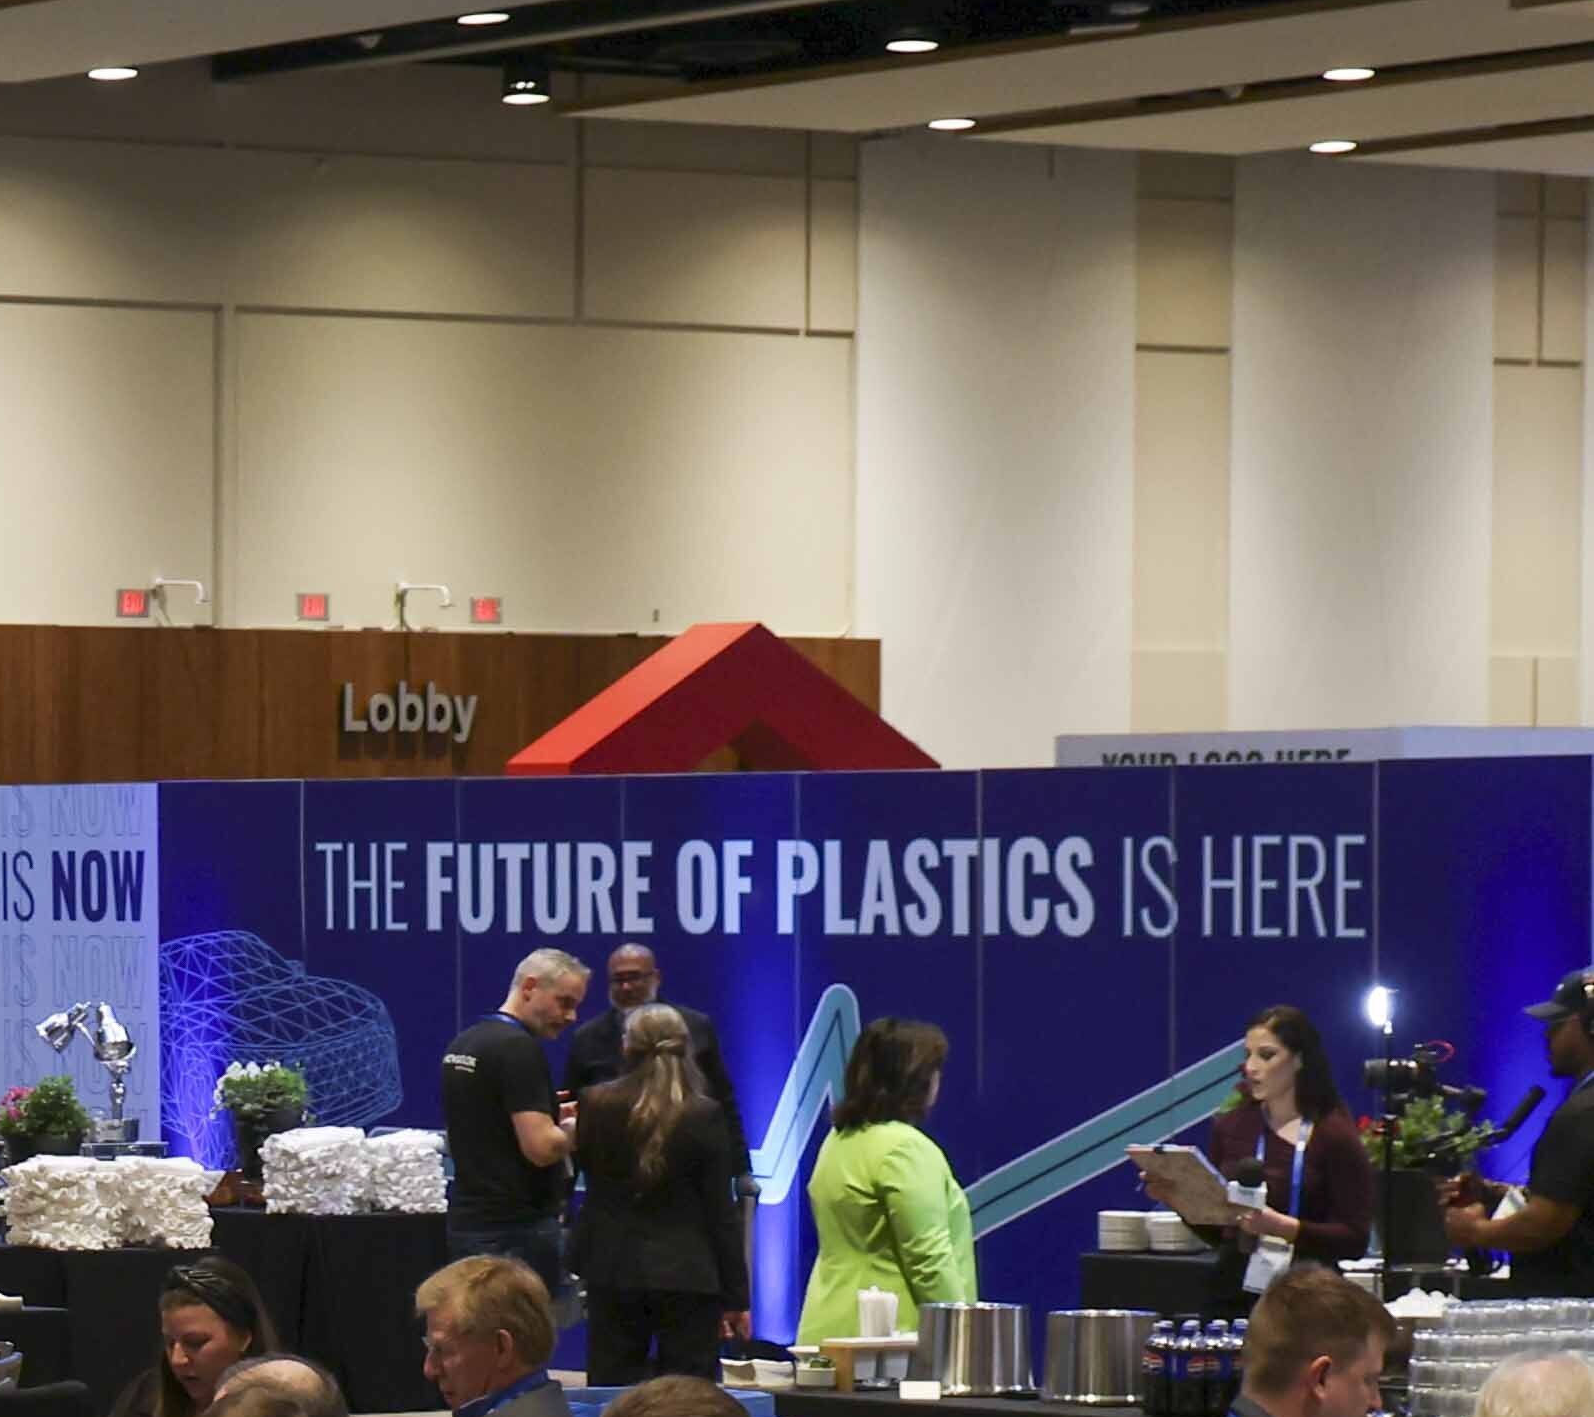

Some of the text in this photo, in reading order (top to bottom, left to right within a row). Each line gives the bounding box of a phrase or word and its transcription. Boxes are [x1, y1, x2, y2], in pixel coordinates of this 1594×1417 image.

[343, 681, 477, 743] Lobby
[2, 850, 35, 921] IS
[51, 849, 145, 923] NOW
[316, 835, 1366, 938] THE FUTURE OF PLASTICS IS HERE
